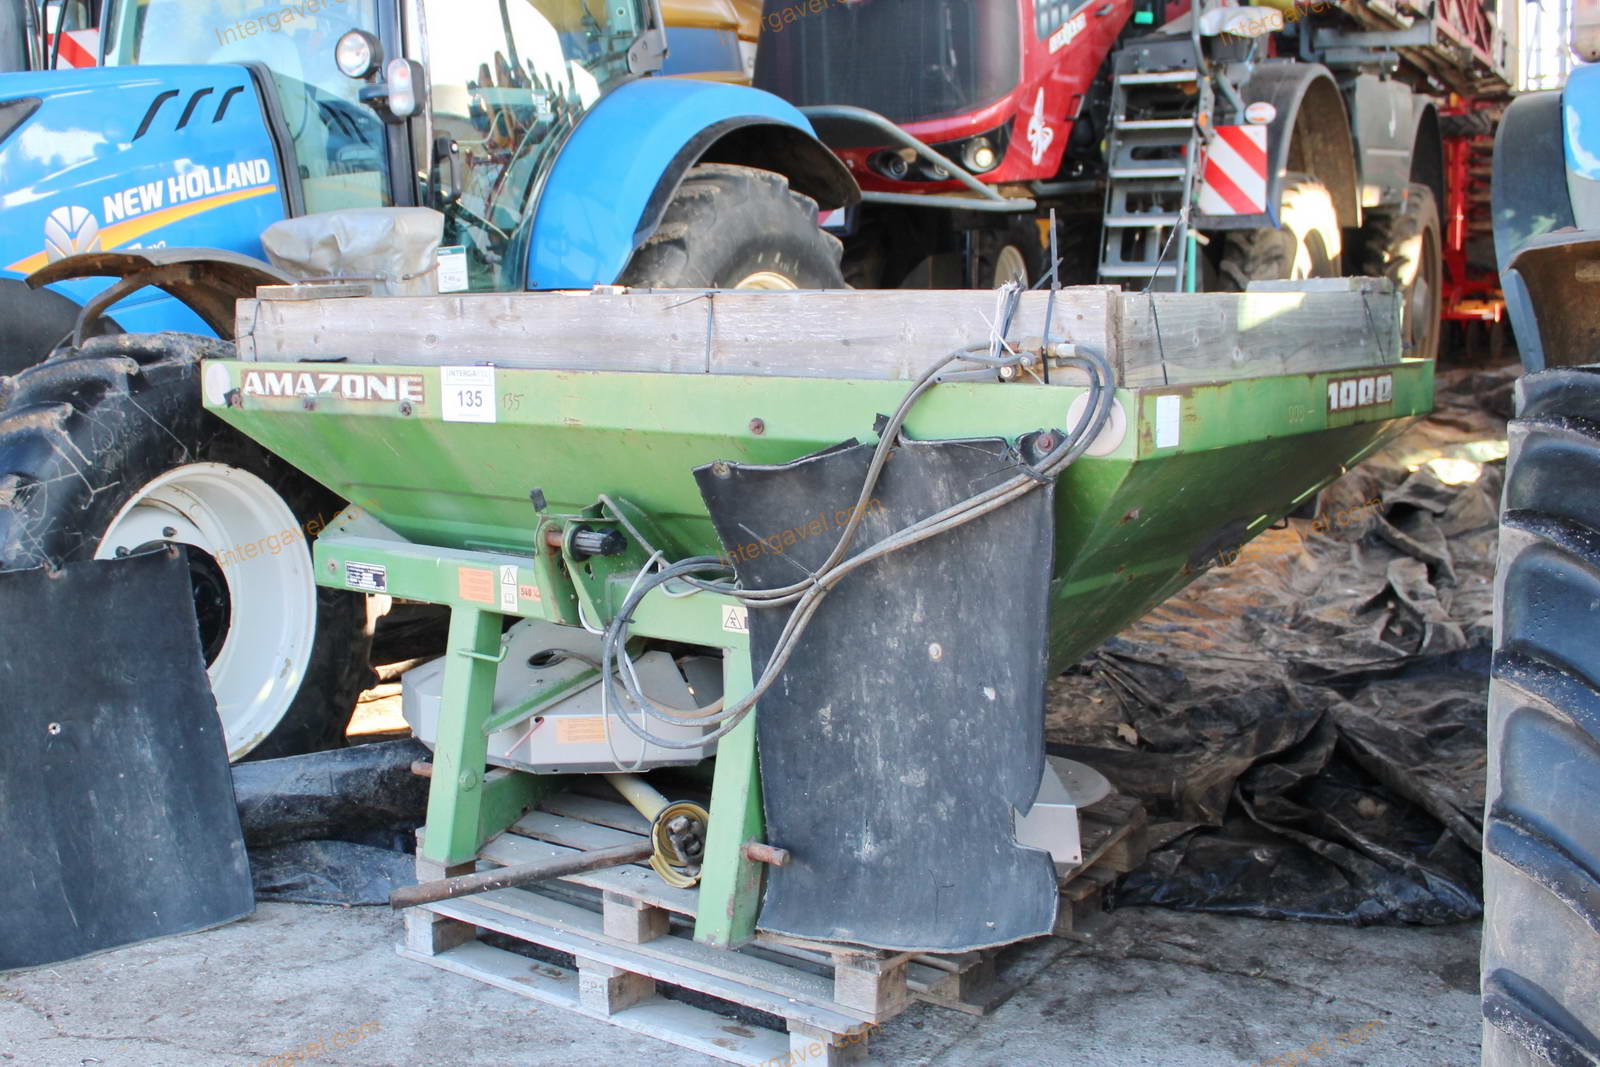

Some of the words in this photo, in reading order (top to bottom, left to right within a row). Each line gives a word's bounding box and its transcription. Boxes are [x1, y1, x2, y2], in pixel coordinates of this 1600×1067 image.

[103, 180, 164, 224] NEW
[167, 158, 271, 203] HOLLAND
[242, 371, 424, 402] AMAZONE
[457, 390, 483, 408] 135
[1327, 374, 1393, 412] 1000
